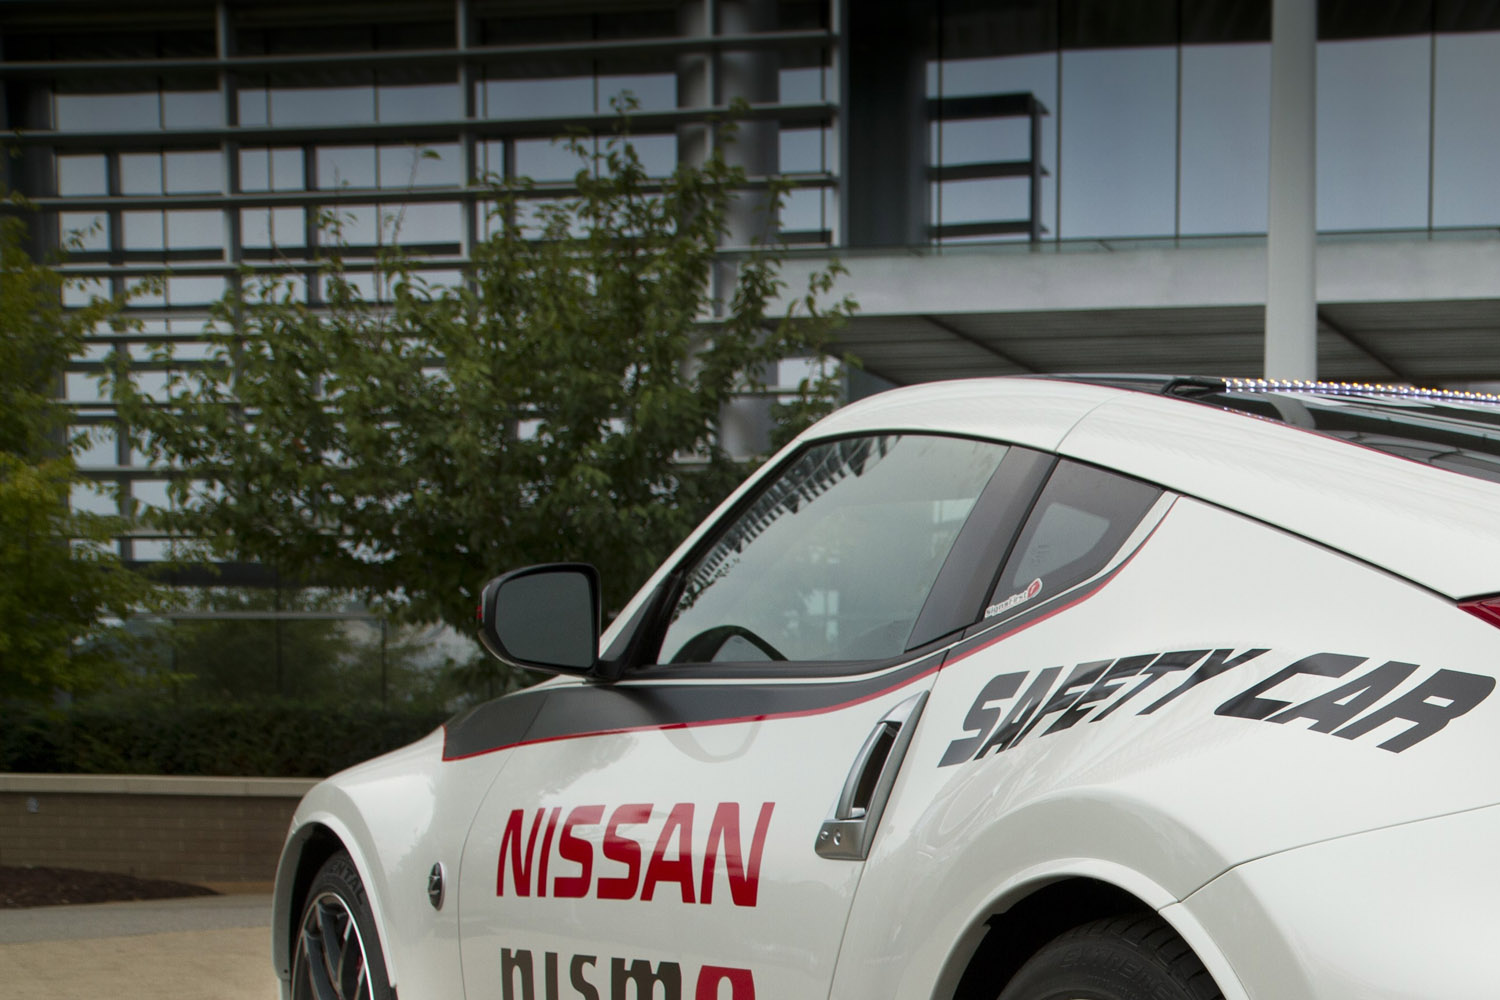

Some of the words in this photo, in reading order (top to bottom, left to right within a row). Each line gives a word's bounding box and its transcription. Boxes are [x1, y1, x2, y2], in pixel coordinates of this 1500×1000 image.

[937, 648, 1272, 767] SAFETY
[1214, 652, 1496, 753] CAR
[496, 801, 776, 907] NISSAN
